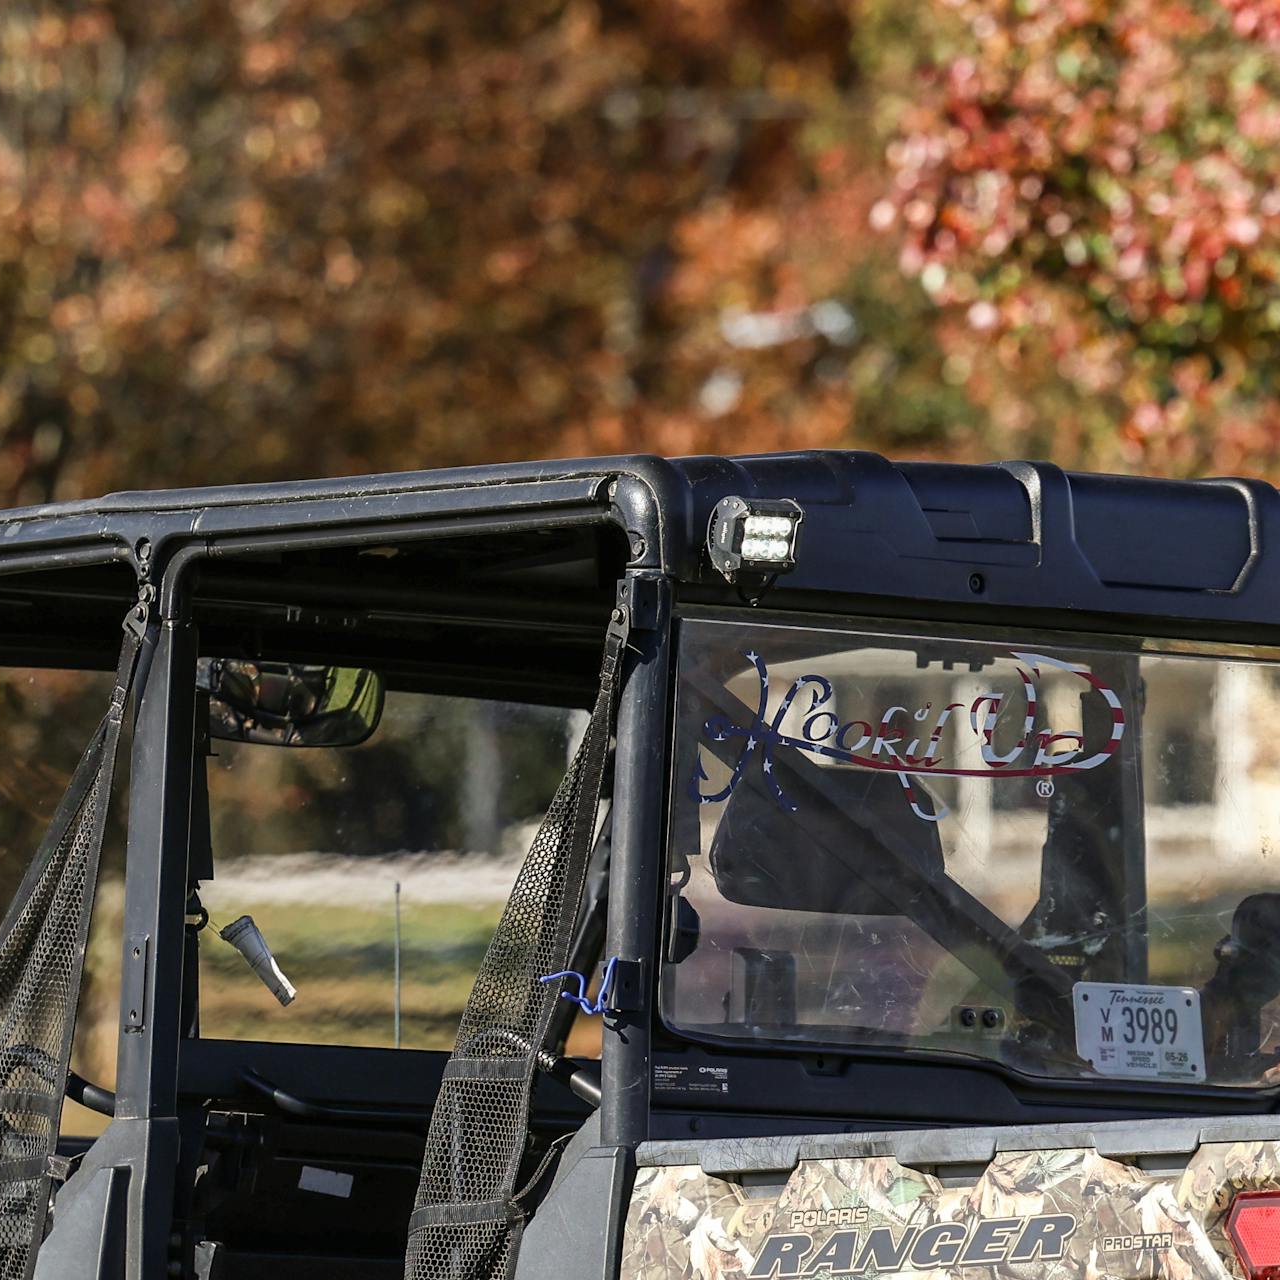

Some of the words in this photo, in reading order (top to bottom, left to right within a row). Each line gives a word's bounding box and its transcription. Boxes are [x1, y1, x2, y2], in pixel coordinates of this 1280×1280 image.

[970, 648, 1126, 778] Up
[1109, 989, 1166, 1005] Tennessee
[1121, 1006, 1178, 1045] 3989
[789, 1206, 869, 1229] POLARIS
[1102, 1231, 1174, 1253] PROSTAR
